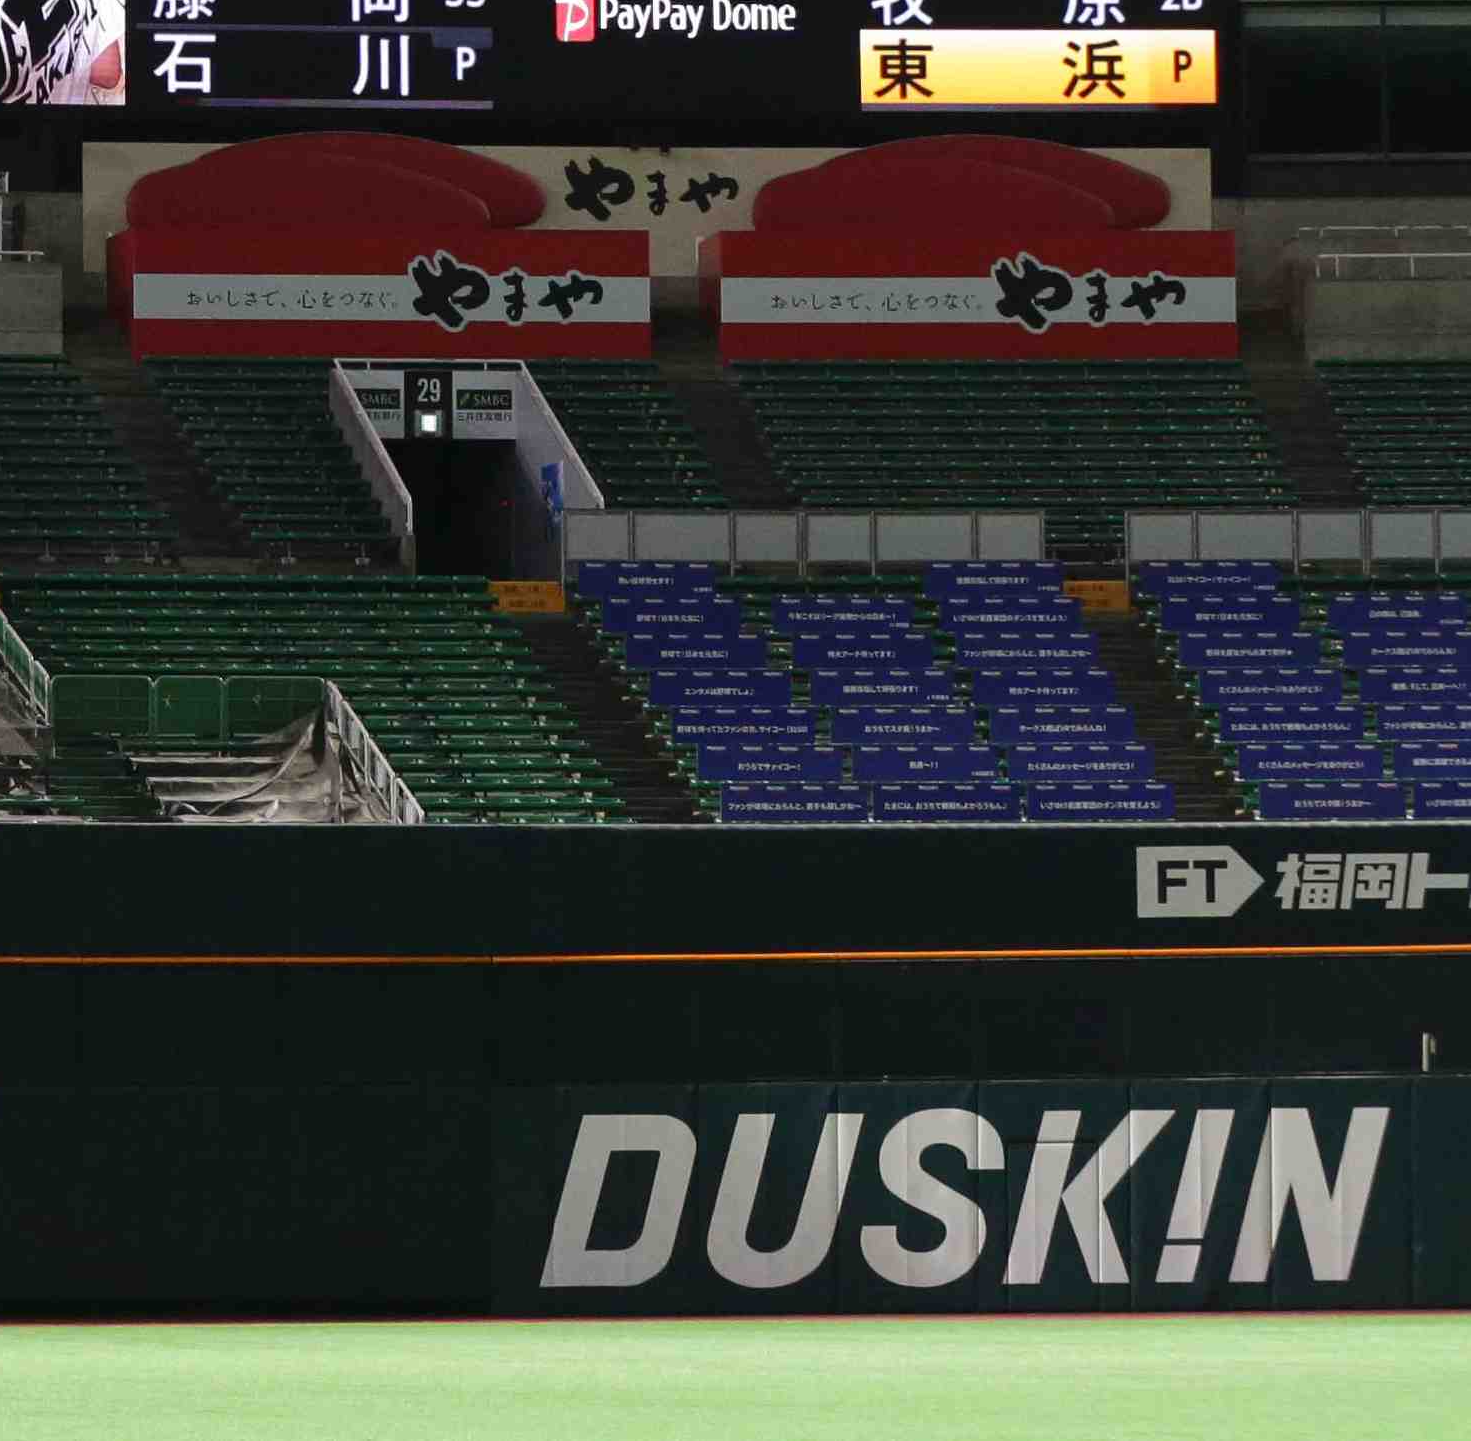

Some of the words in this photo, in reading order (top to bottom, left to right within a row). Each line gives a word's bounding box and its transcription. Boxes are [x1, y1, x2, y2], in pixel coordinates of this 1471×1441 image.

[455, 46, 476, 81] P
[1173, 49, 1193, 83] P
[563, 156, 740, 222] やまや
[411, 251, 605, 331] やまや
[993, 253, 1187, 331] やまや
[416, 377, 442, 403] 29
[473, 392, 510, 406] SMBC
[1157, 860, 1227, 904] FT
